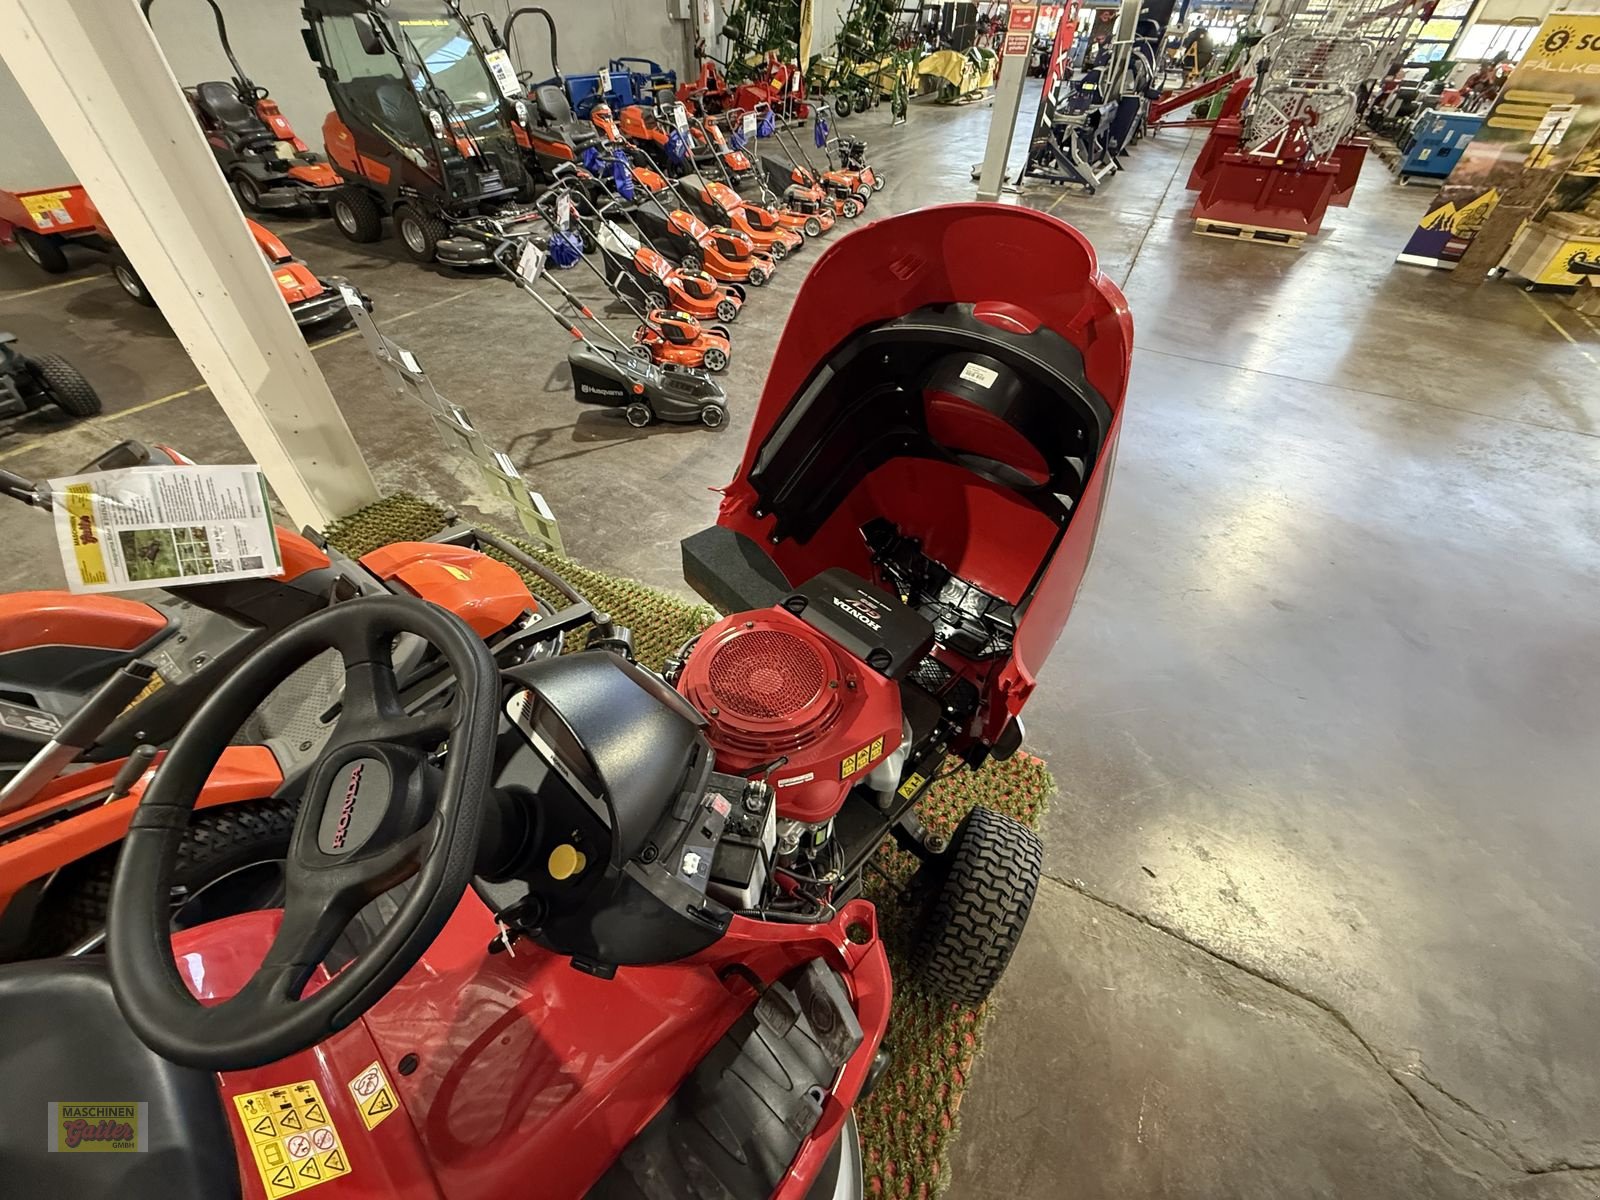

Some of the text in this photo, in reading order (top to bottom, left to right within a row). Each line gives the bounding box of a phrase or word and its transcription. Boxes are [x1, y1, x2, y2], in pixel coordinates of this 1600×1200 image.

[588, 386, 624, 396] Husqvarna
[833, 597, 882, 632] HONDA
[332, 763, 364, 849] HONDA
